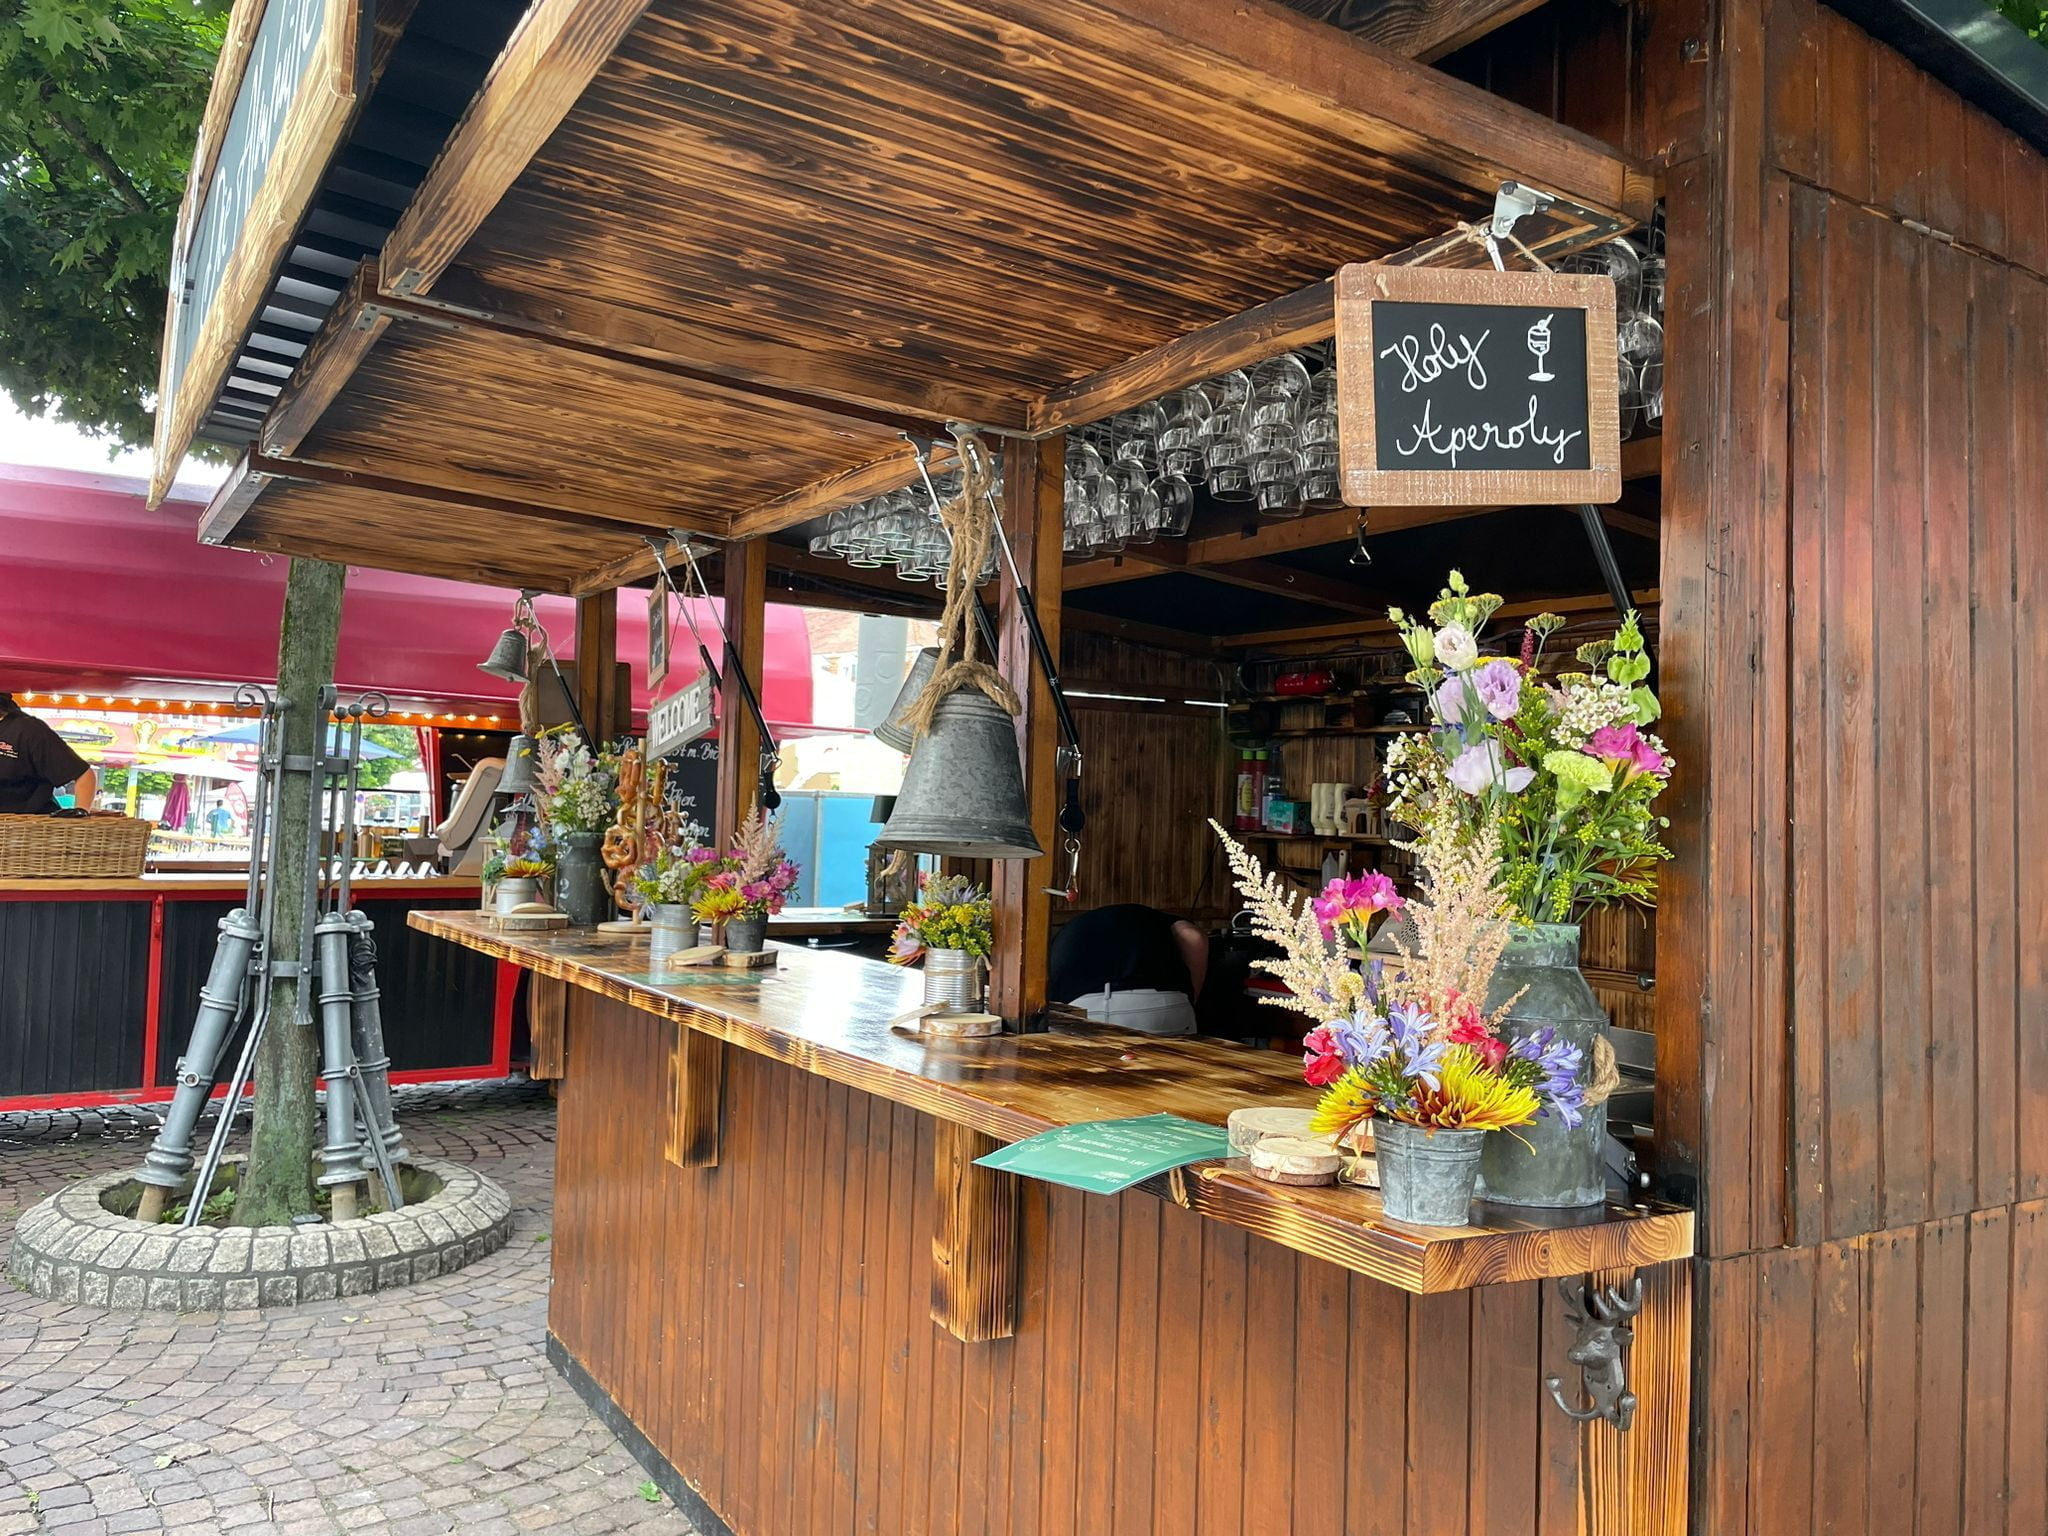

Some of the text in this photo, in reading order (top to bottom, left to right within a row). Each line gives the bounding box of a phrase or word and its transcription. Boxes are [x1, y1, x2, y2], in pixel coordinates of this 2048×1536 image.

[1380, 322, 1491, 393] Holy
[1395, 394, 1582, 468] Aperoly
[651, 686, 701, 749] WELCOME
